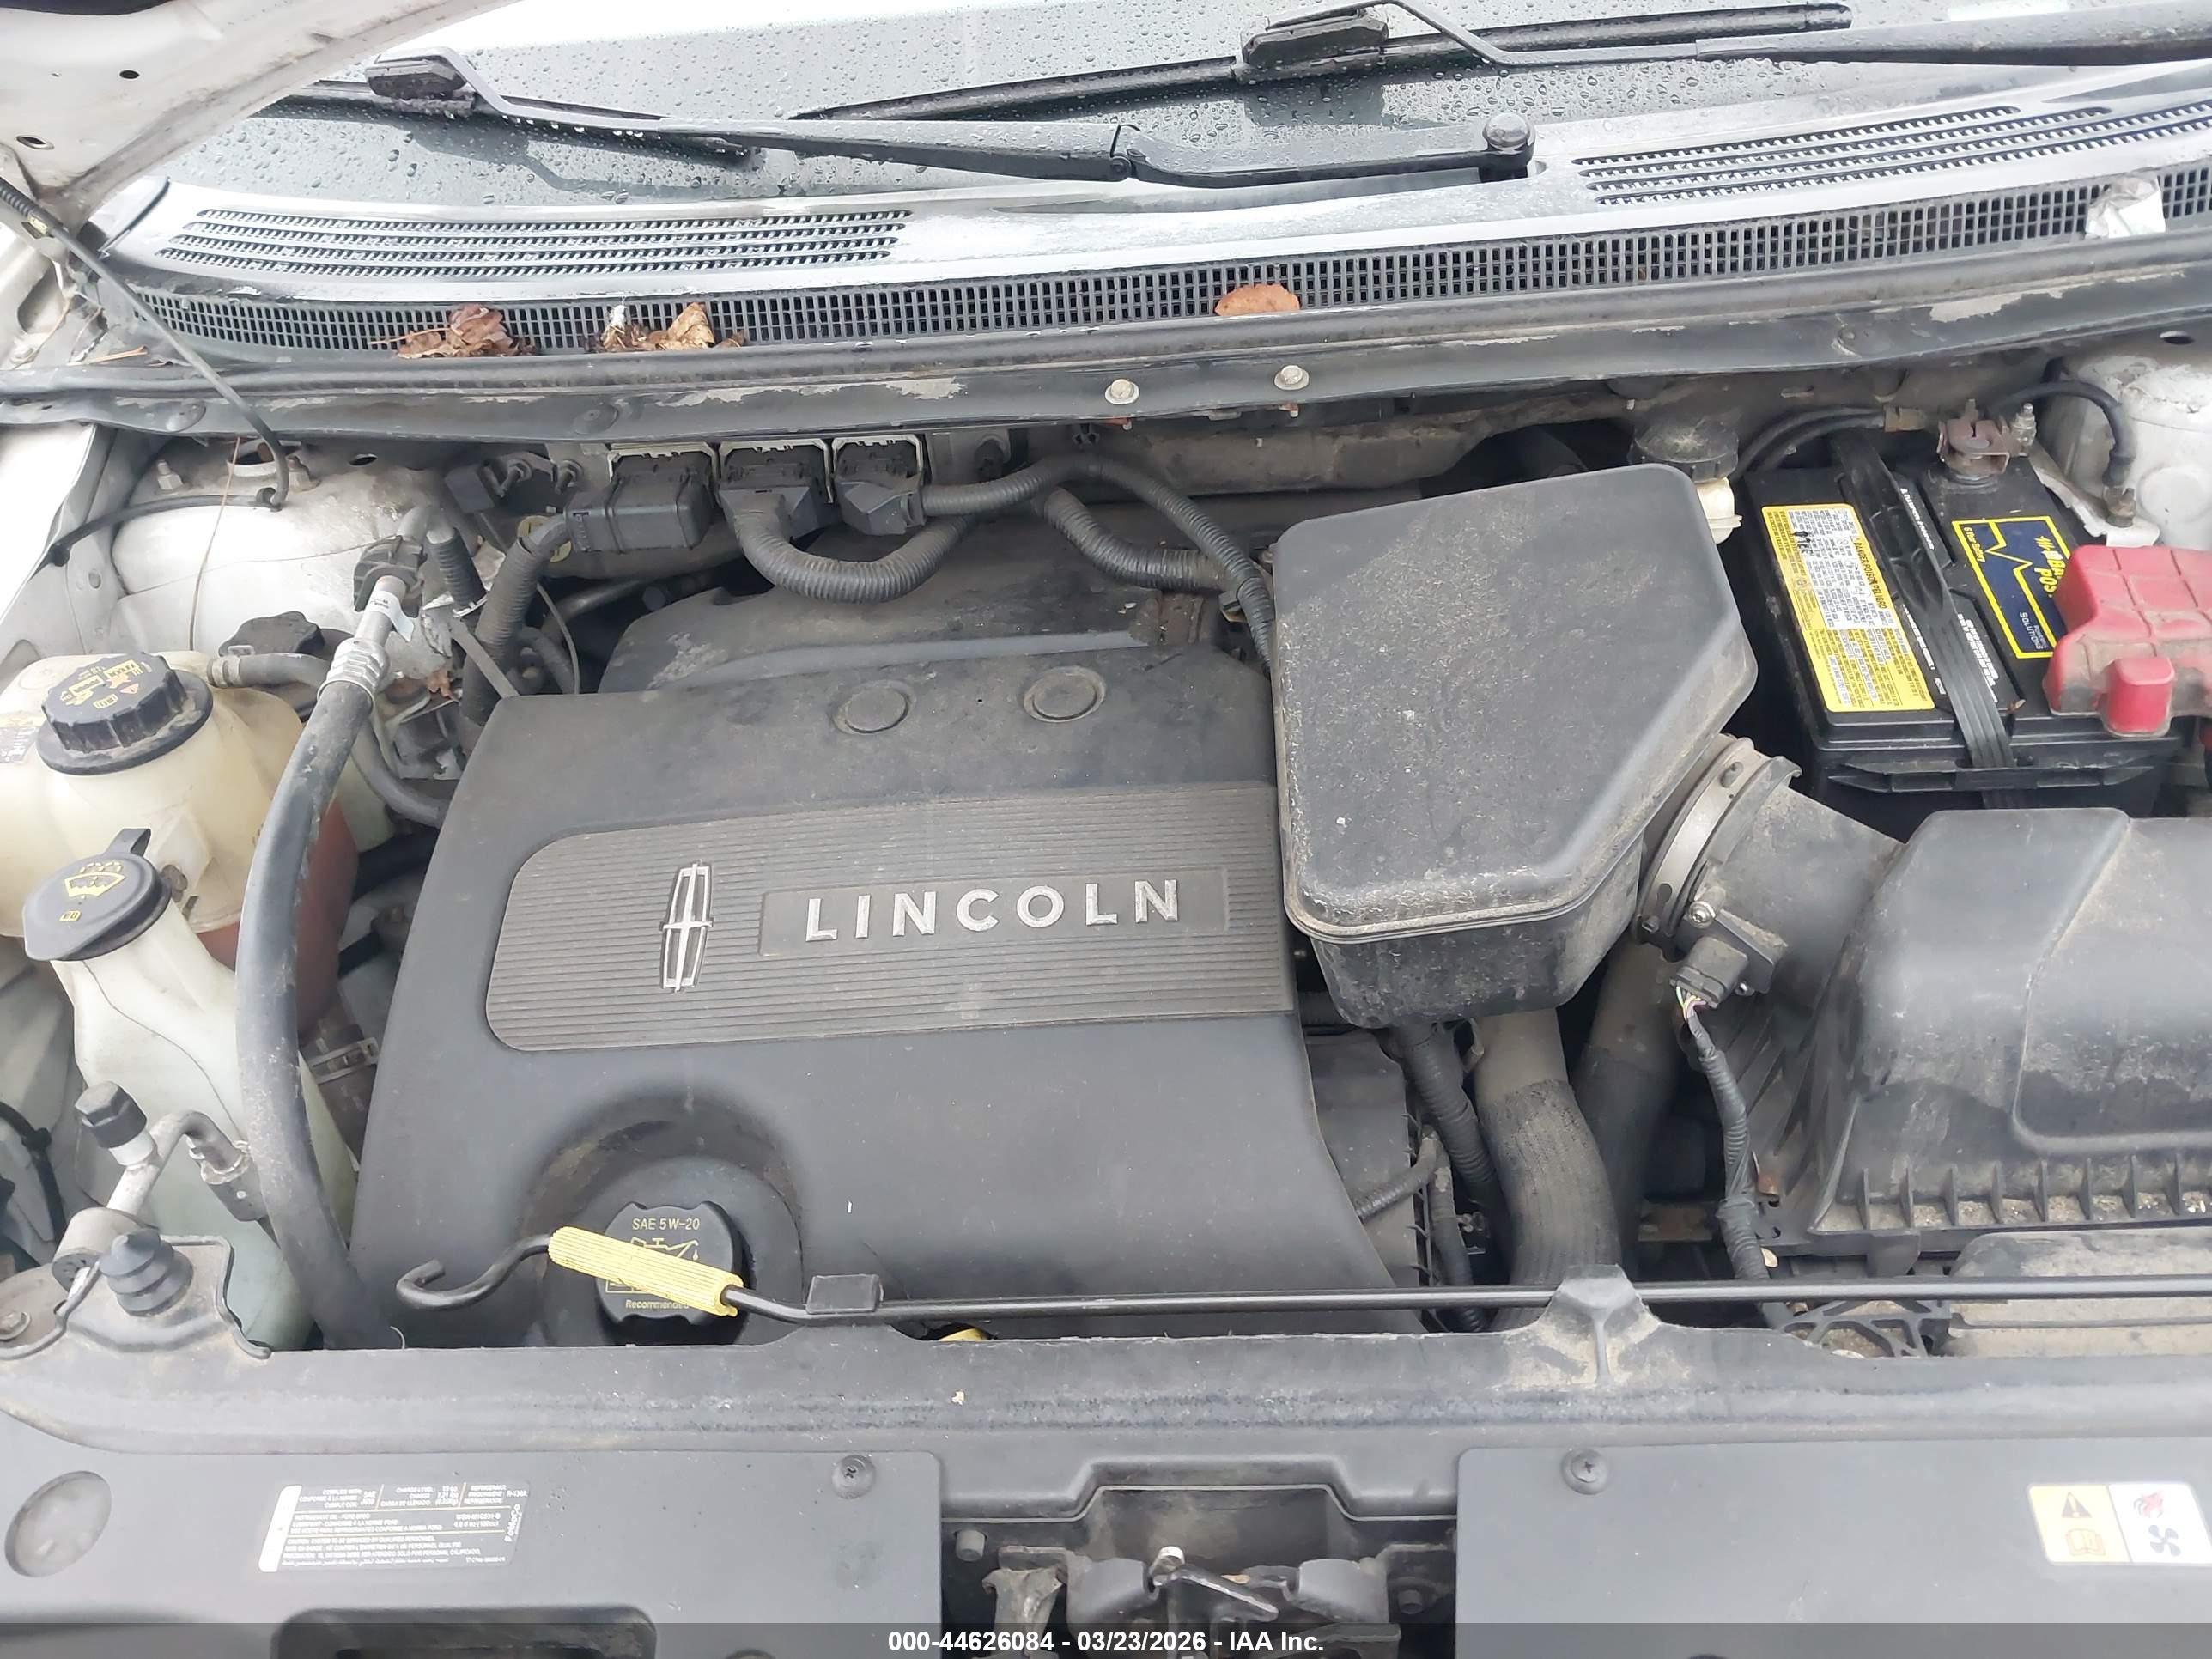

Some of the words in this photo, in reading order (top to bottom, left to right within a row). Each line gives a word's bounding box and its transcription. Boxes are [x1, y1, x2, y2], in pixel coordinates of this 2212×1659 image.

[2019, 611, 2044, 650] SOLUTIONS
[805, 879, 1179, 942] LINCOLN
[632, 1218, 655, 1231] SAE
[659, 1218, 701, 1231] 5W-20
